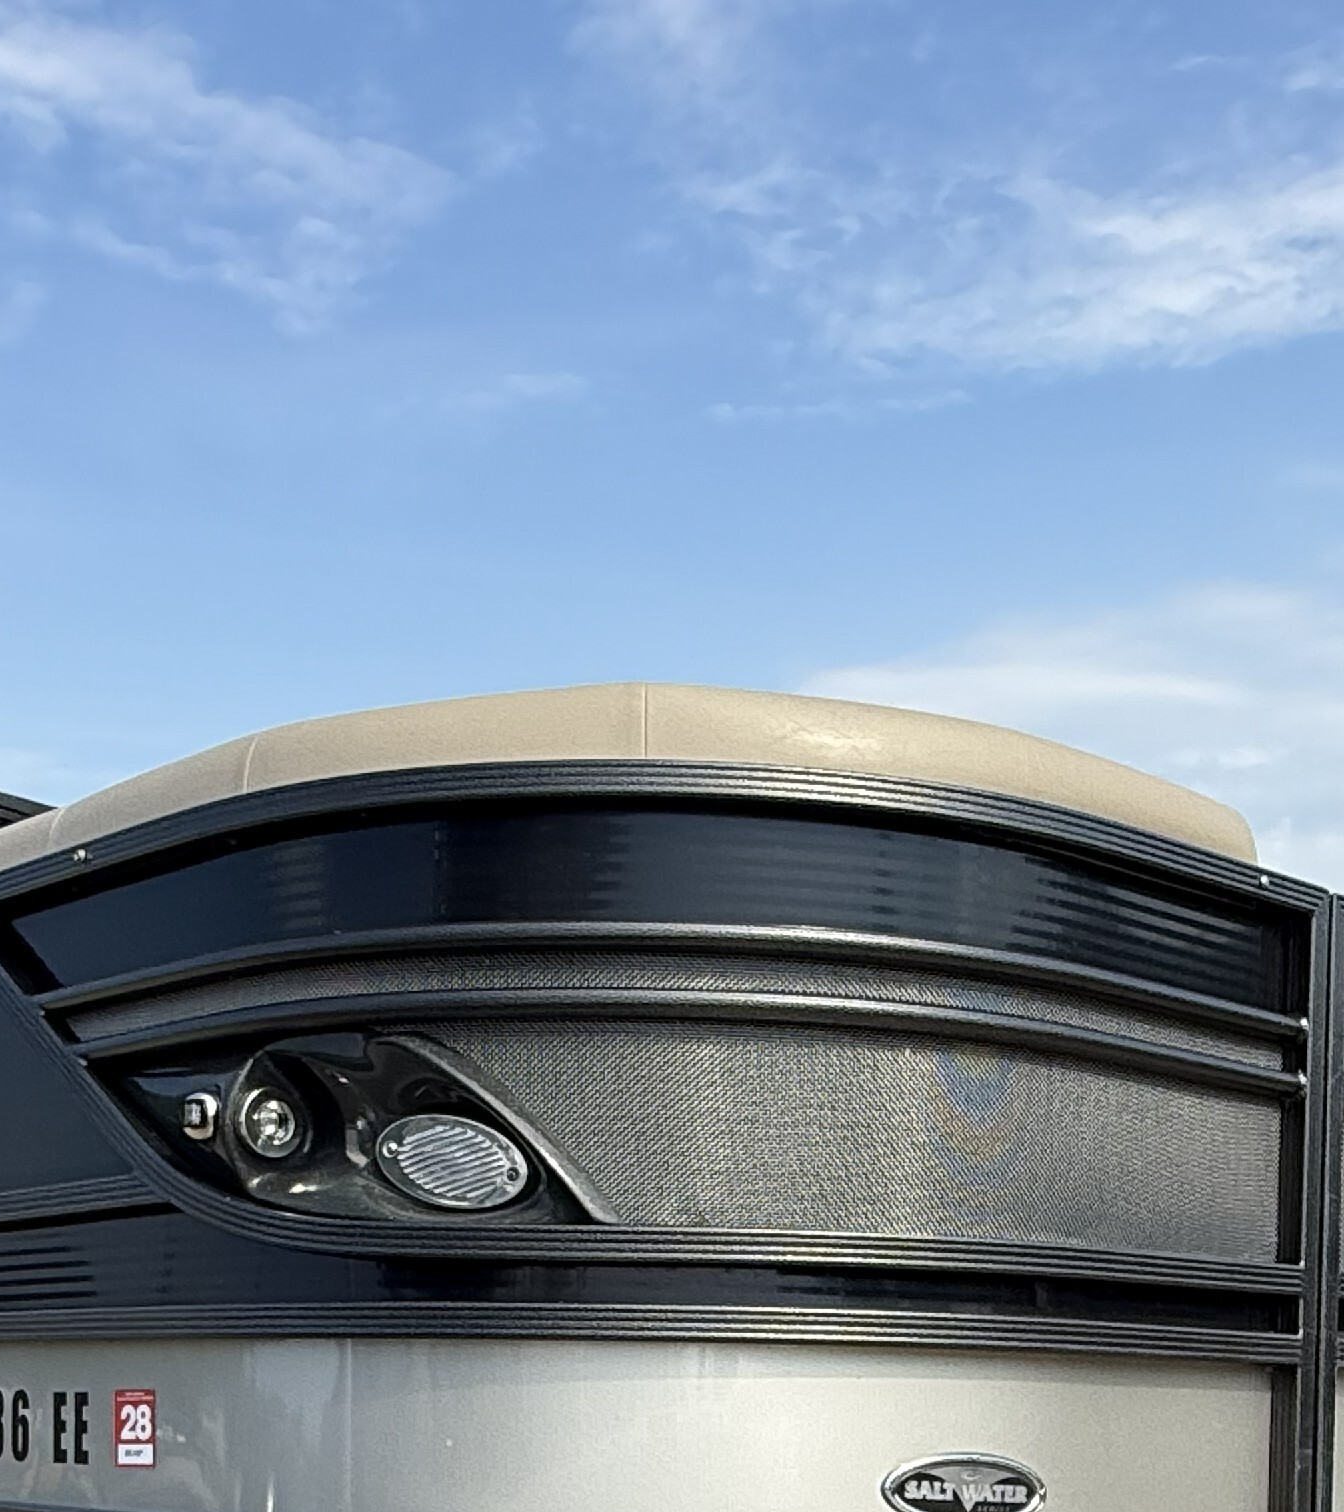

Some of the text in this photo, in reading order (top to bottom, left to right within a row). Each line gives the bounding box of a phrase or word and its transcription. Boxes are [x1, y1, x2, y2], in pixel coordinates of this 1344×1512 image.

[53, 1391, 90, 1465] EE
[120, 1404, 152, 1441] 28
[904, 1480, 1028, 1504] SALT WATER
